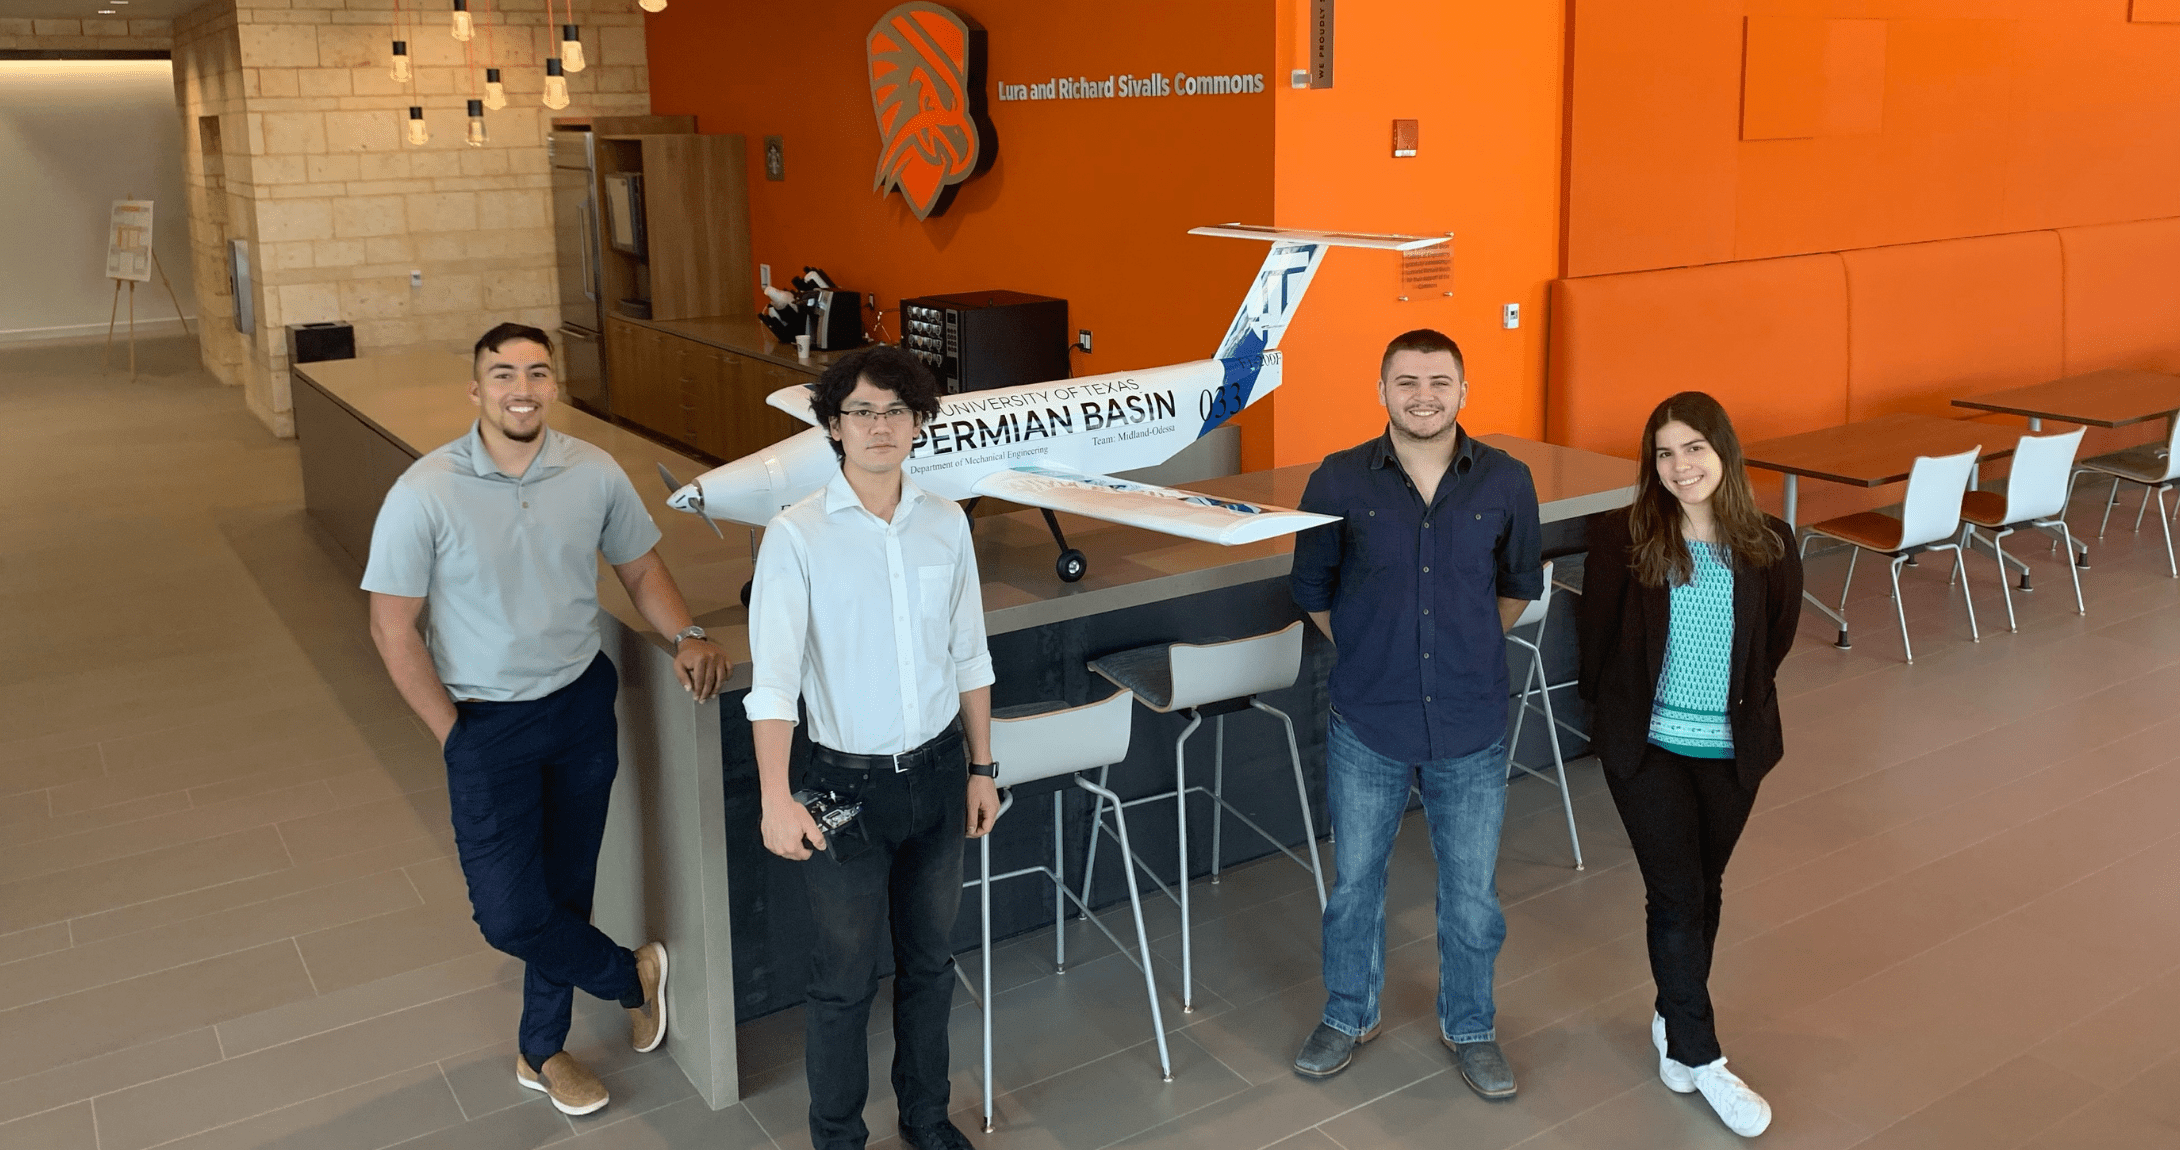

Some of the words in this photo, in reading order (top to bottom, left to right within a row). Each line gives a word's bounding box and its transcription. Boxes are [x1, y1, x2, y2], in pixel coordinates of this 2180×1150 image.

[1318, 7, 1326, 58] PROUDLY
[998, 81, 1027, 101] Lura
[1030, 78, 1056, 100] and
[1059, 75, 1115, 100] Richard
[1118, 73, 1170, 98] Sivalls
[1174, 72, 1264, 96] Commons
[1318, 63, 1325, 79] WE
[939, 391, 1049, 417] UNIVERSITY
[1054, 386, 1080, 401] OF
[1081, 378, 1140, 397] TEXAS
[1199, 382, 1242, 421] 033
[909, 405, 1074, 459] PERMIAN
[1080, 389, 1177, 431] BASIN
[1092, 434, 1116, 447] Team:
[1118, 424, 1176, 442] Midland-Odessa
[910, 461, 954, 475] Department
[955, 457, 964, 468] of
[965, 452, 1006, 466] Mechanical
[1007, 445, 1049, 460] Engineering
